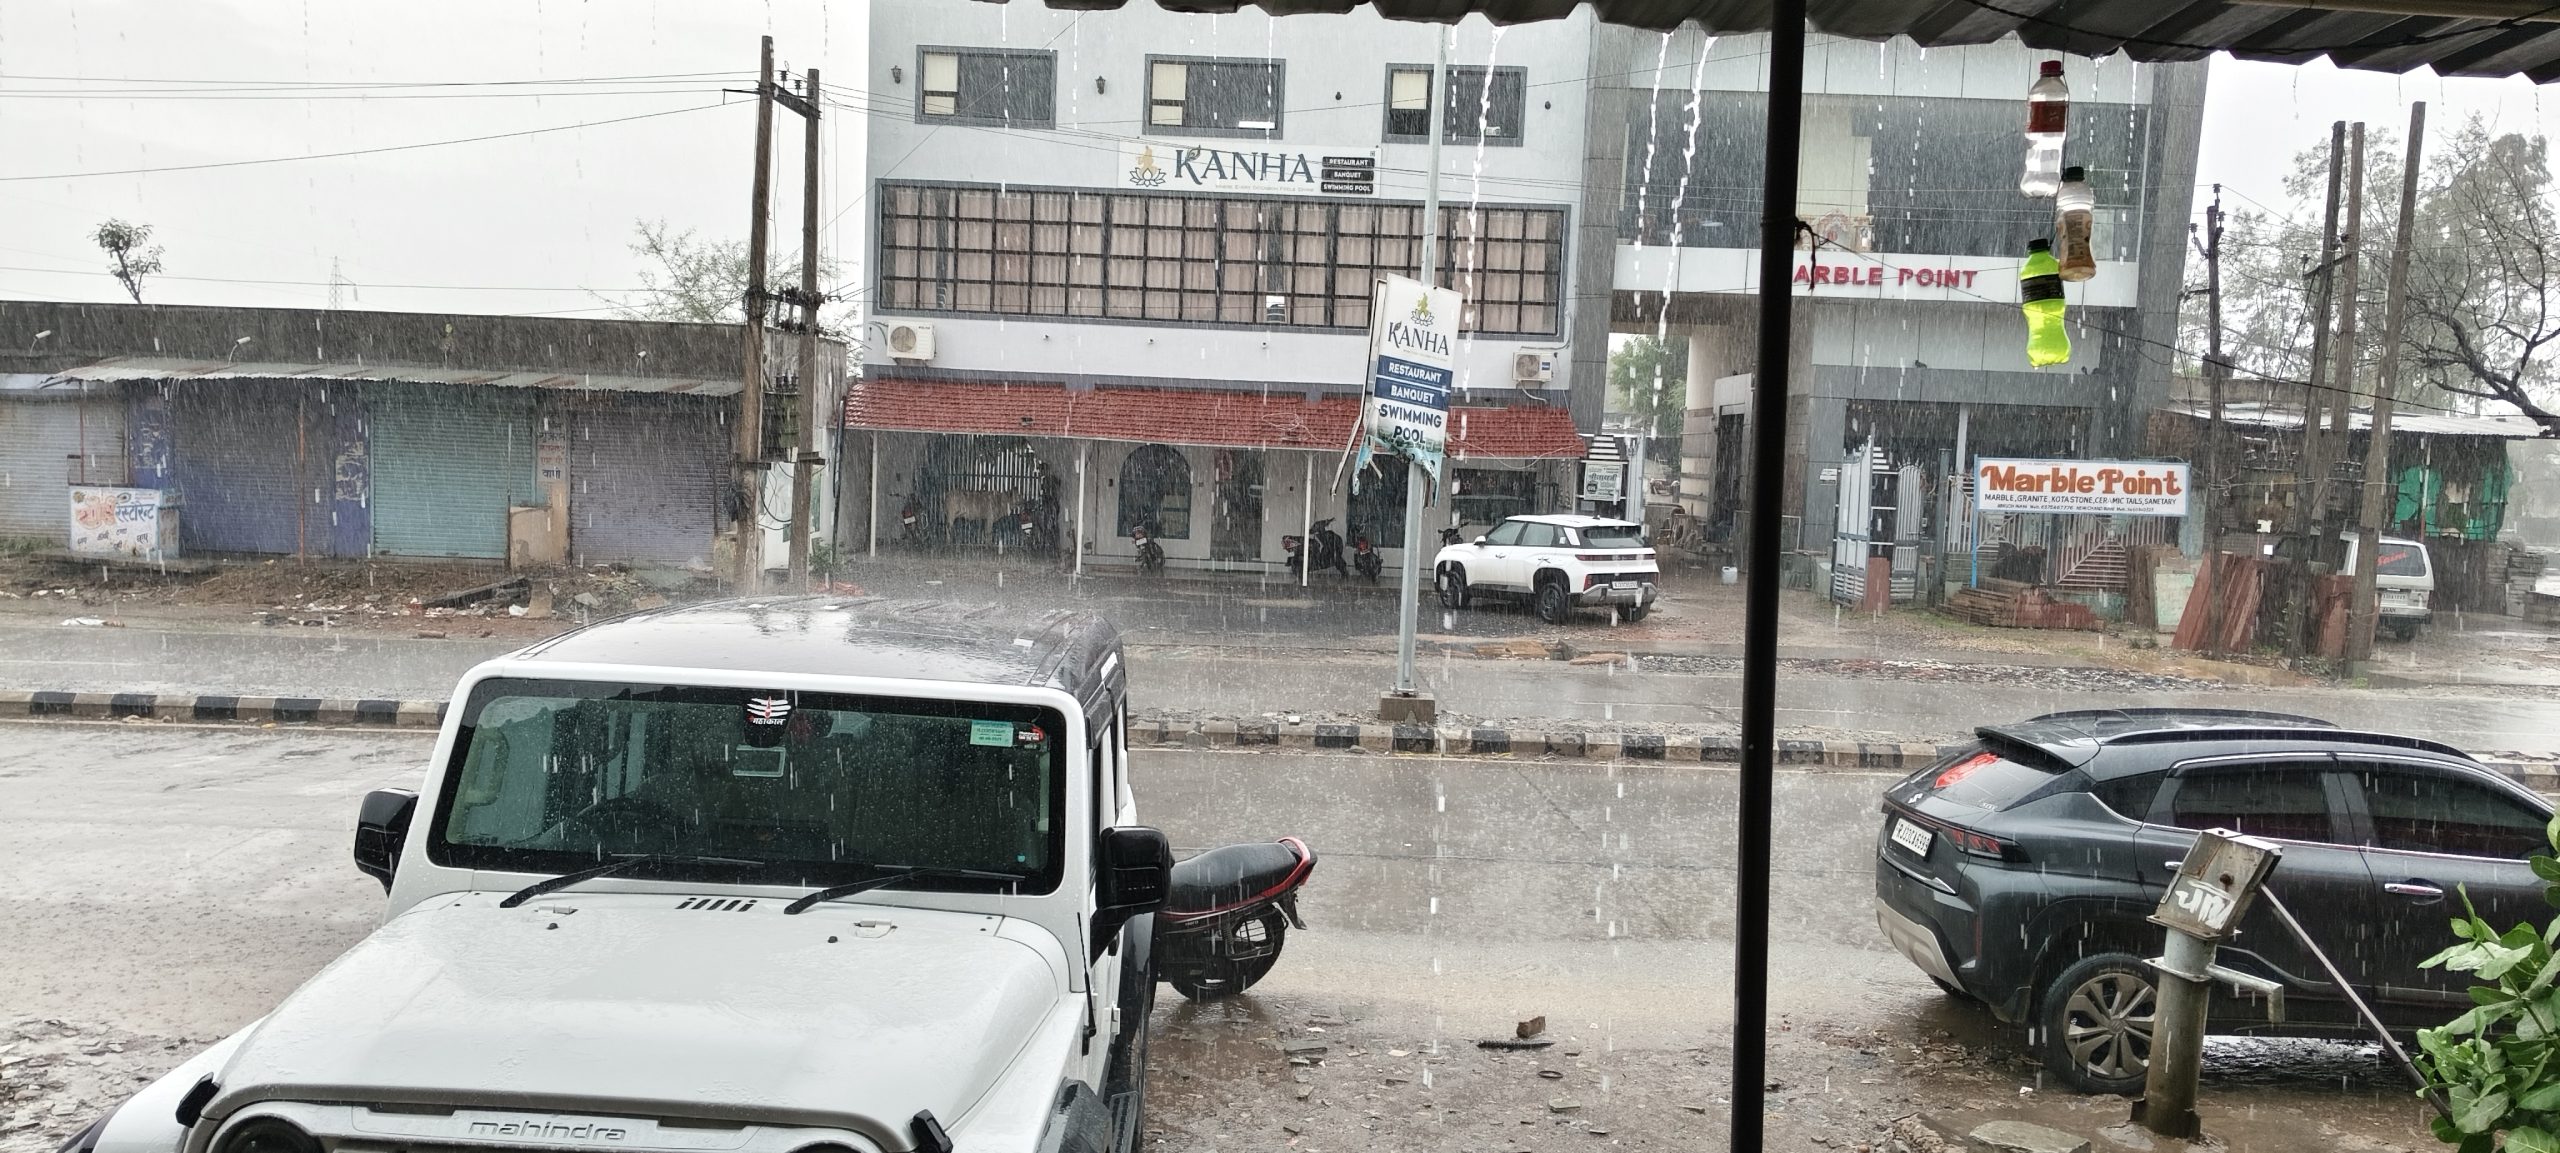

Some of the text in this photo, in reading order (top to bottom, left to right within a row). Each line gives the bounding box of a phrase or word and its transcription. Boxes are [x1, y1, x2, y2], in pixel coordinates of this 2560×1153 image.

[1175, 147, 1315, 185] KANHA
[1329, 158, 1369, 166] RESTAURANT
[1323, 183, 1354, 191] SWIMMING
[1793, 264, 1978, 289] ARBLE POINT
[1388, 321, 1449, 356] KANHA
[1388, 362, 1443, 383] RESTAURANT
[1390, 384, 1435, 405] BANQUET
[1379, 403, 1442, 428] SWIMMING
[1393, 426, 1426, 444] POOL
[1981, 465, 2182, 496] Marble Point
[468, 1120, 627, 1141] mahindra
